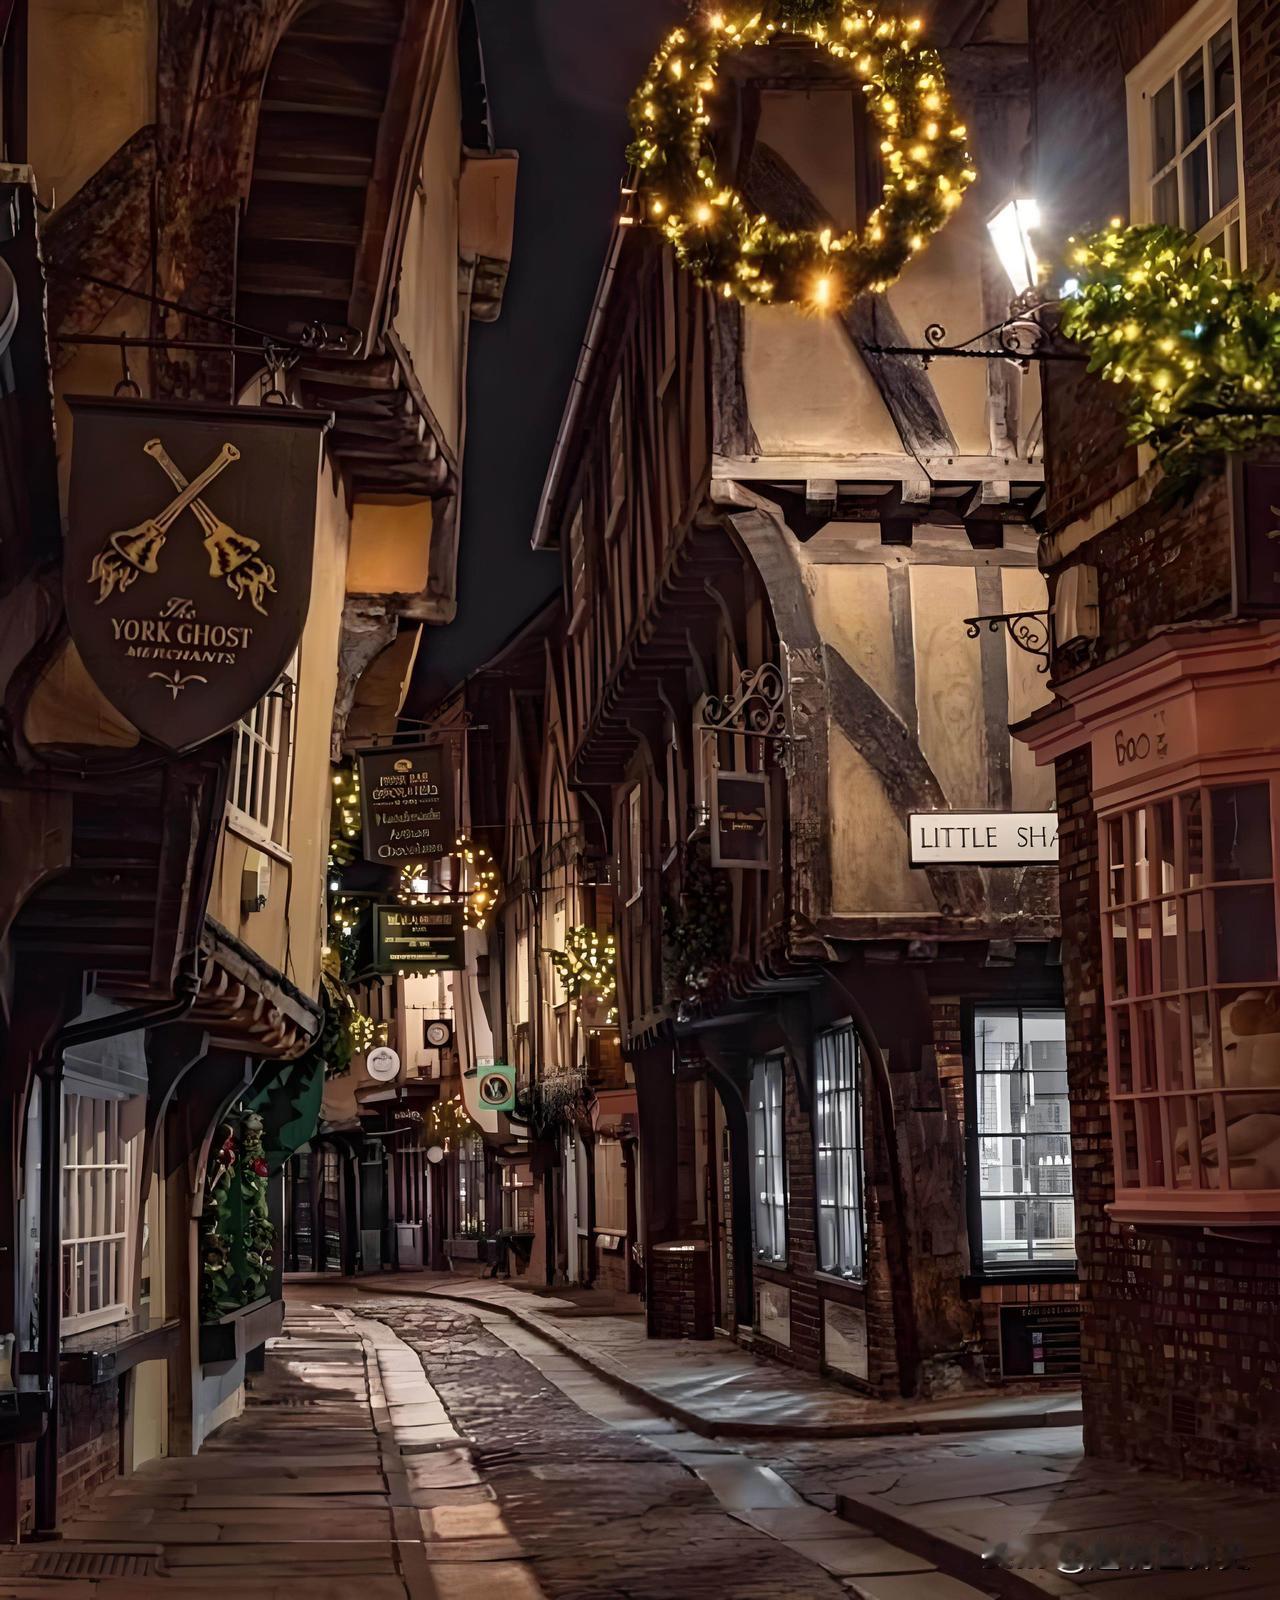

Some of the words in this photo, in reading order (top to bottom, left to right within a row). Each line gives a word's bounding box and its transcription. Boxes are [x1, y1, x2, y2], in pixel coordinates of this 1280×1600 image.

[111, 618, 171, 644] YORK
[176, 623, 253, 649] GHOST
[921, 827, 997, 848] LITTLE
